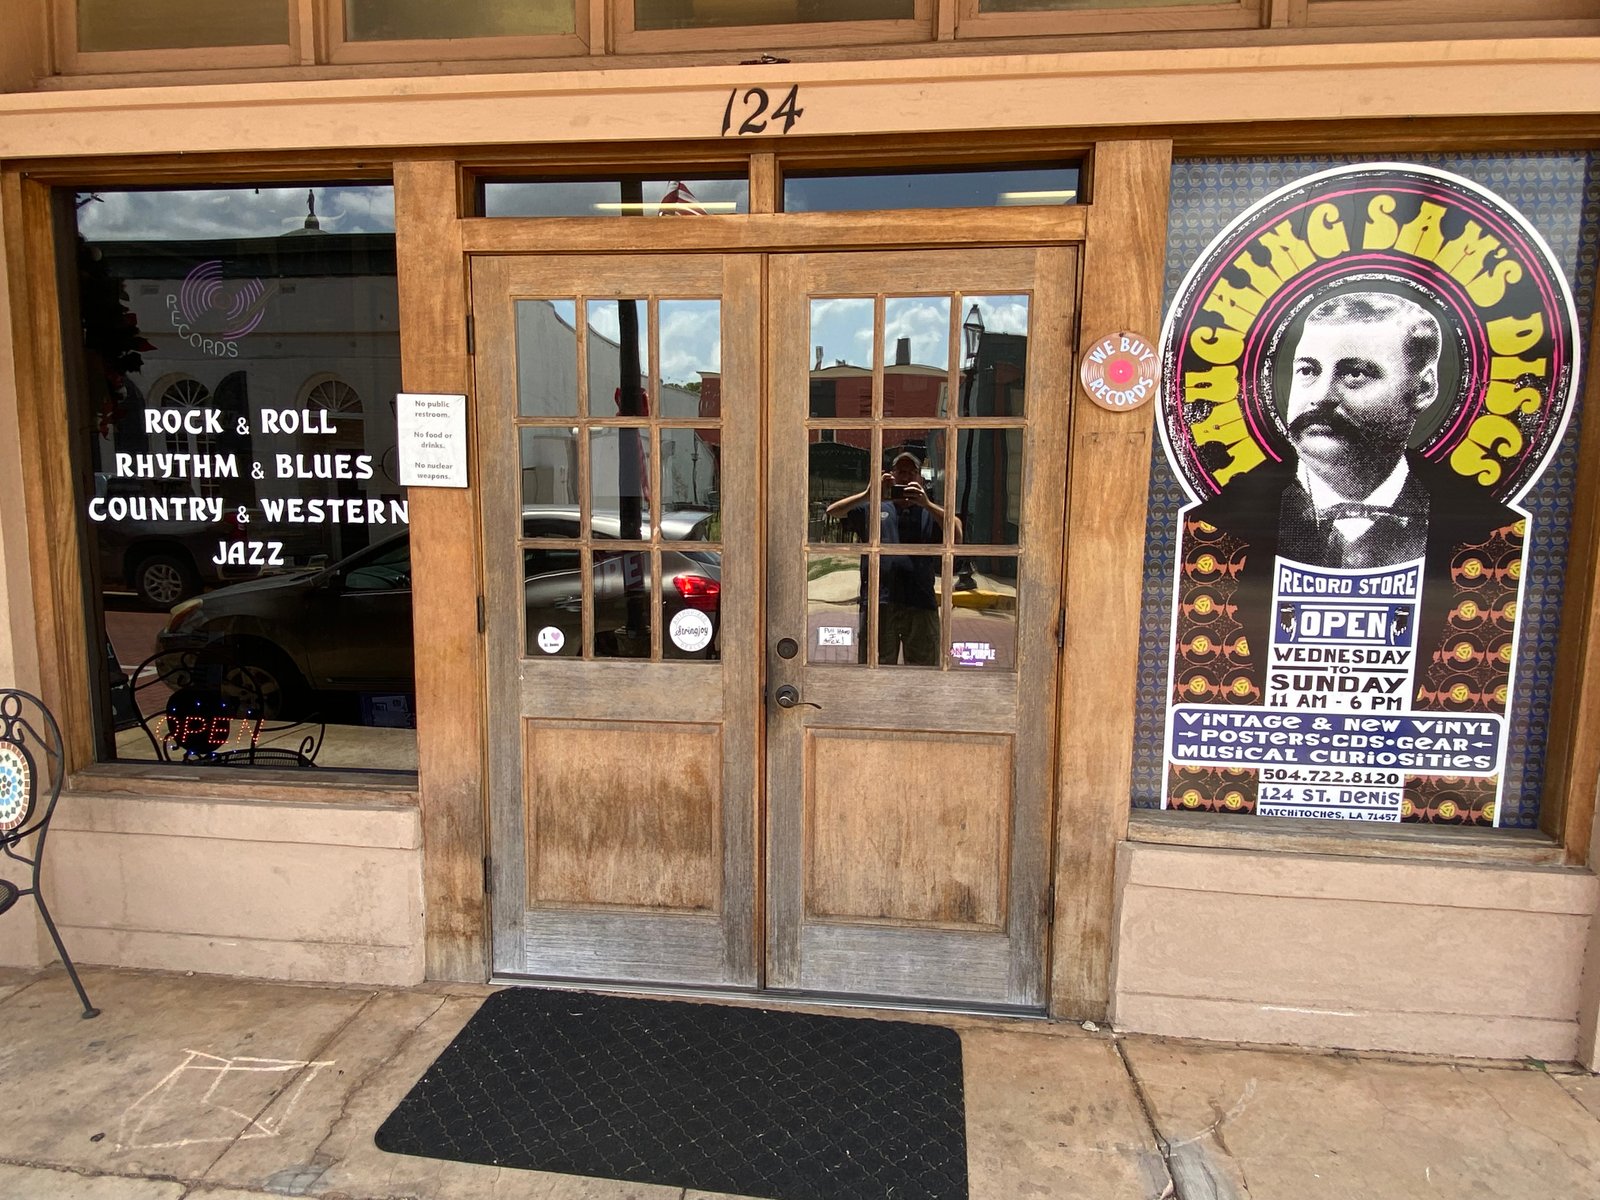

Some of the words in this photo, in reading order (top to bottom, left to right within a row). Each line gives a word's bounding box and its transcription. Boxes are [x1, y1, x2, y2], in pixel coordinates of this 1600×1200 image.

[722, 84, 804, 137] 124
[166, 294, 239, 358] RECORDS
[1089, 340, 1116, 364] WE
[1120, 336, 1154, 362] BUY
[1185, 202, 1351, 487] LAUGHING
[1361, 194, 1523, 308] SAM'S
[1450, 311, 1547, 487] DISCS
[1089, 376, 1154, 406] RECORDS
[427, 401, 450, 409] public
[144, 408, 224, 434] ROCK
[236, 416, 250, 436] &
[260, 408, 337, 434] ROLL
[115, 453, 239, 479] RHYTHM
[251, 461, 265, 480] &
[275, 454, 374, 480] BLUES
[88, 497, 223, 522] COUNTRY
[236, 505, 250, 524] &
[260, 499, 410, 525] WESTERN
[212, 540, 285, 566] JAZZ
[1279, 567, 1353, 594] RECORD
[1358, 570, 1417, 595] STORE
[1300, 610, 1388, 638] OPEN
[1273, 647, 1411, 665] WEDNESDAY
[1330, 665, 1350, 674] TO
[1270, 674, 1407, 693] SUNDAY
[1270, 694, 1288, 707] 11
[1296, 694, 1327, 708] AM
[1350, 695, 1362, 710] 6
[1371, 696, 1403, 711] PM
[155, 715, 265, 745] OPEN
[1311, 717, 1332, 731] &
[1263, 768, 1400, 785] 504.722.8120
[1260, 787, 1294, 801] 124
[1302, 789, 1332, 803] ST.
[1349, 811, 1363, 820] LA
[1367, 812, 1398, 822] 71457
